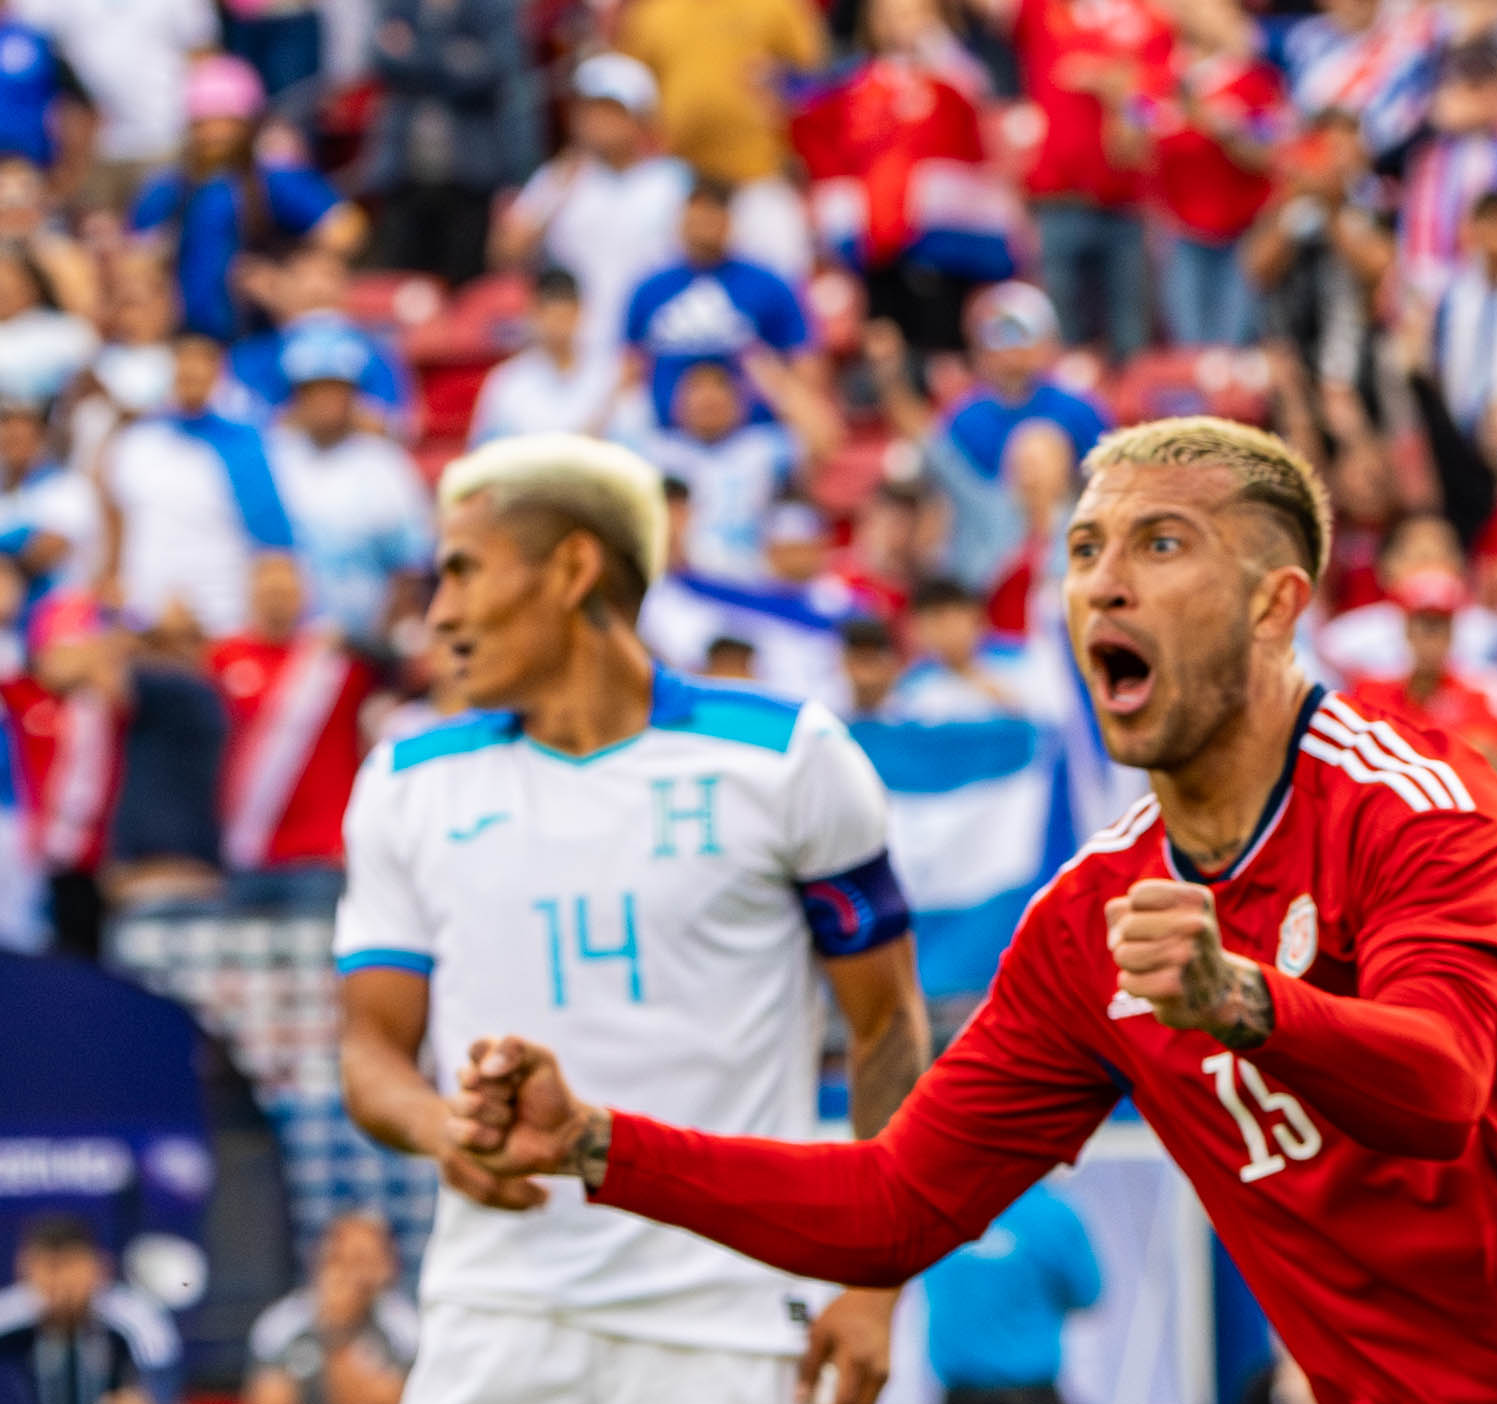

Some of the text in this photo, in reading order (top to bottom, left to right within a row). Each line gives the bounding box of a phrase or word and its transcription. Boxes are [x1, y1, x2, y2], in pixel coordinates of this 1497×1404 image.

[651, 776, 722, 857] H
[532, 893, 643, 1007] 14
[1202, 1051, 1322, 1183] 15
